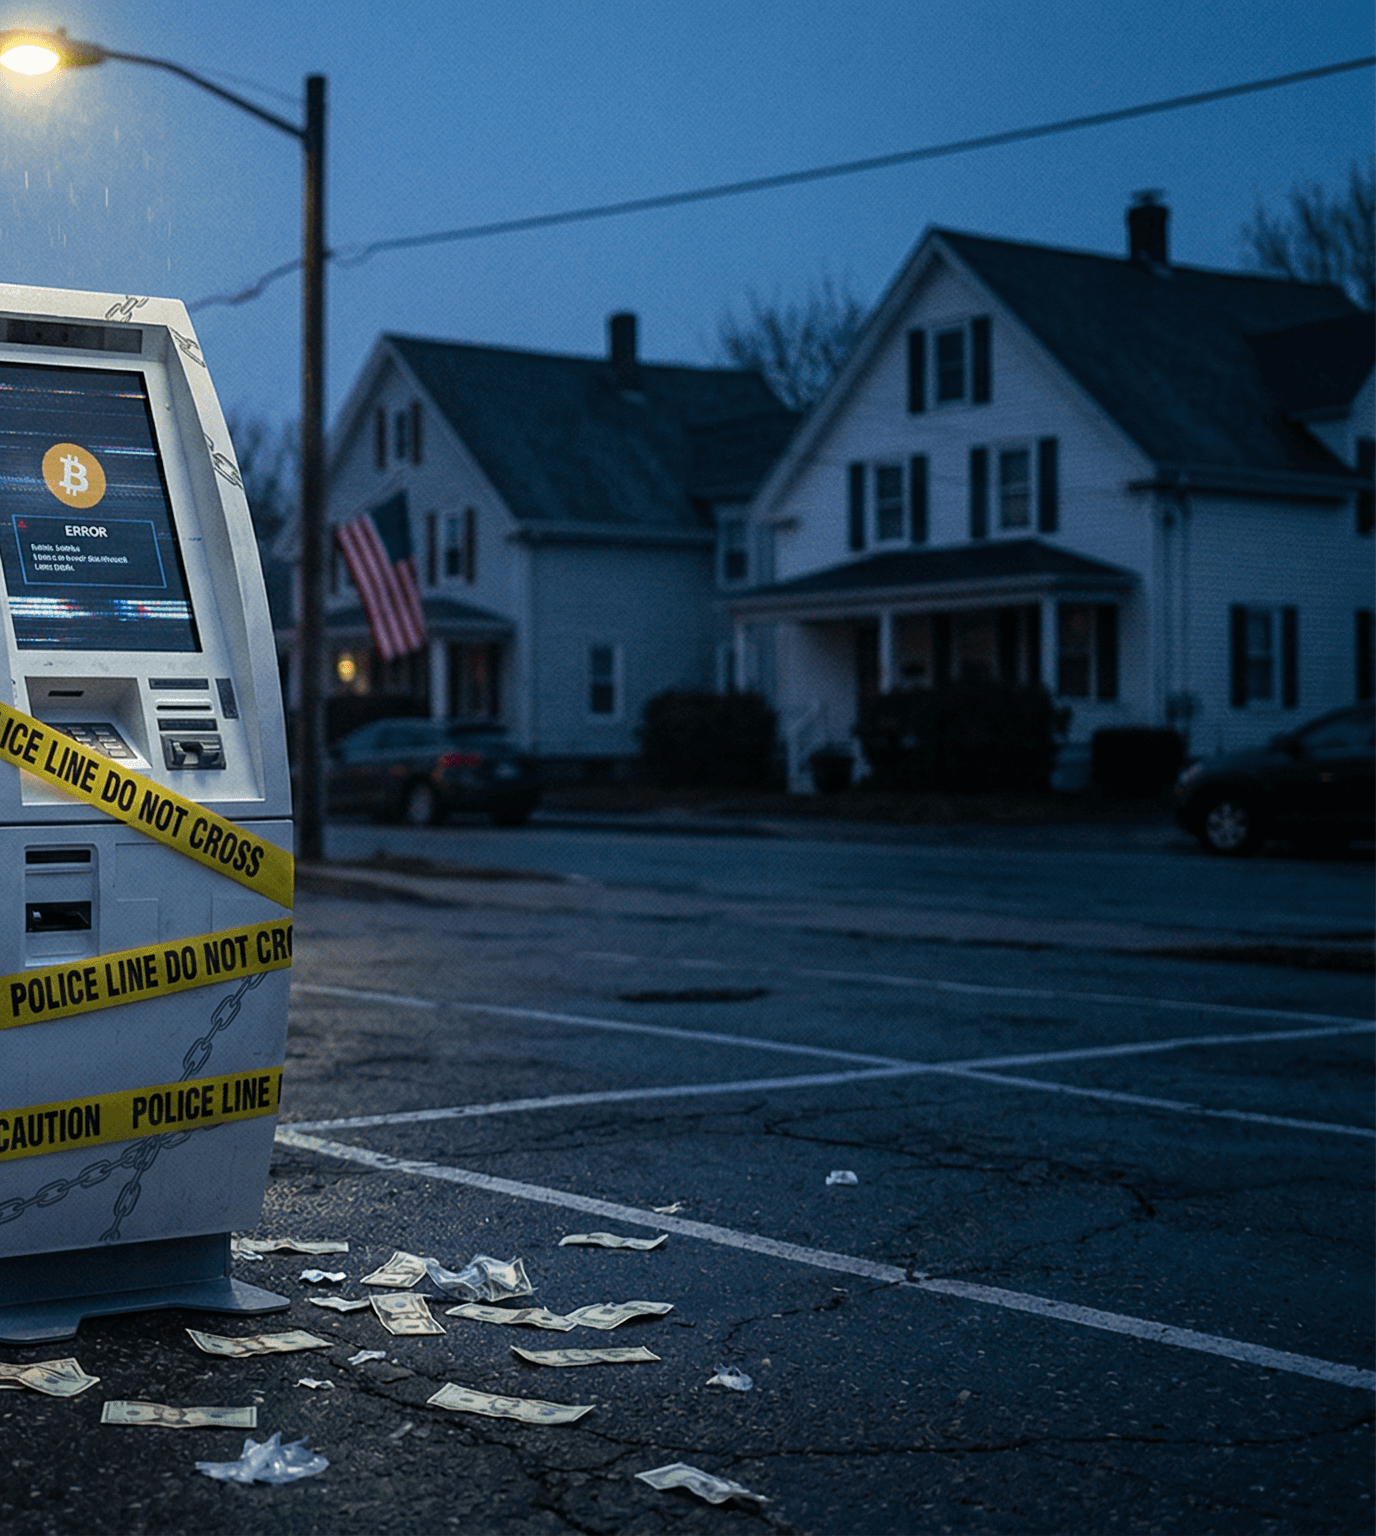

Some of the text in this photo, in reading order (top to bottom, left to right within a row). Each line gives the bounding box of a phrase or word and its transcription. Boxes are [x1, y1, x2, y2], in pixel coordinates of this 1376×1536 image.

[64, 525, 108, 538] ERROR
[43, 739, 100, 794] LINE
[101, 771, 137, 812] DO
[138, 790, 189, 838] NOT
[189, 817, 265, 878] CROSS
[10, 966, 99, 1018] POLICE
[105, 954, 159, 998] LINE
[164, 945, 198, 984] DO
[203, 934, 248, 976] NOT
[132, 1084, 214, 1129] POLICE
[221, 1075, 270, 1114] LINE
